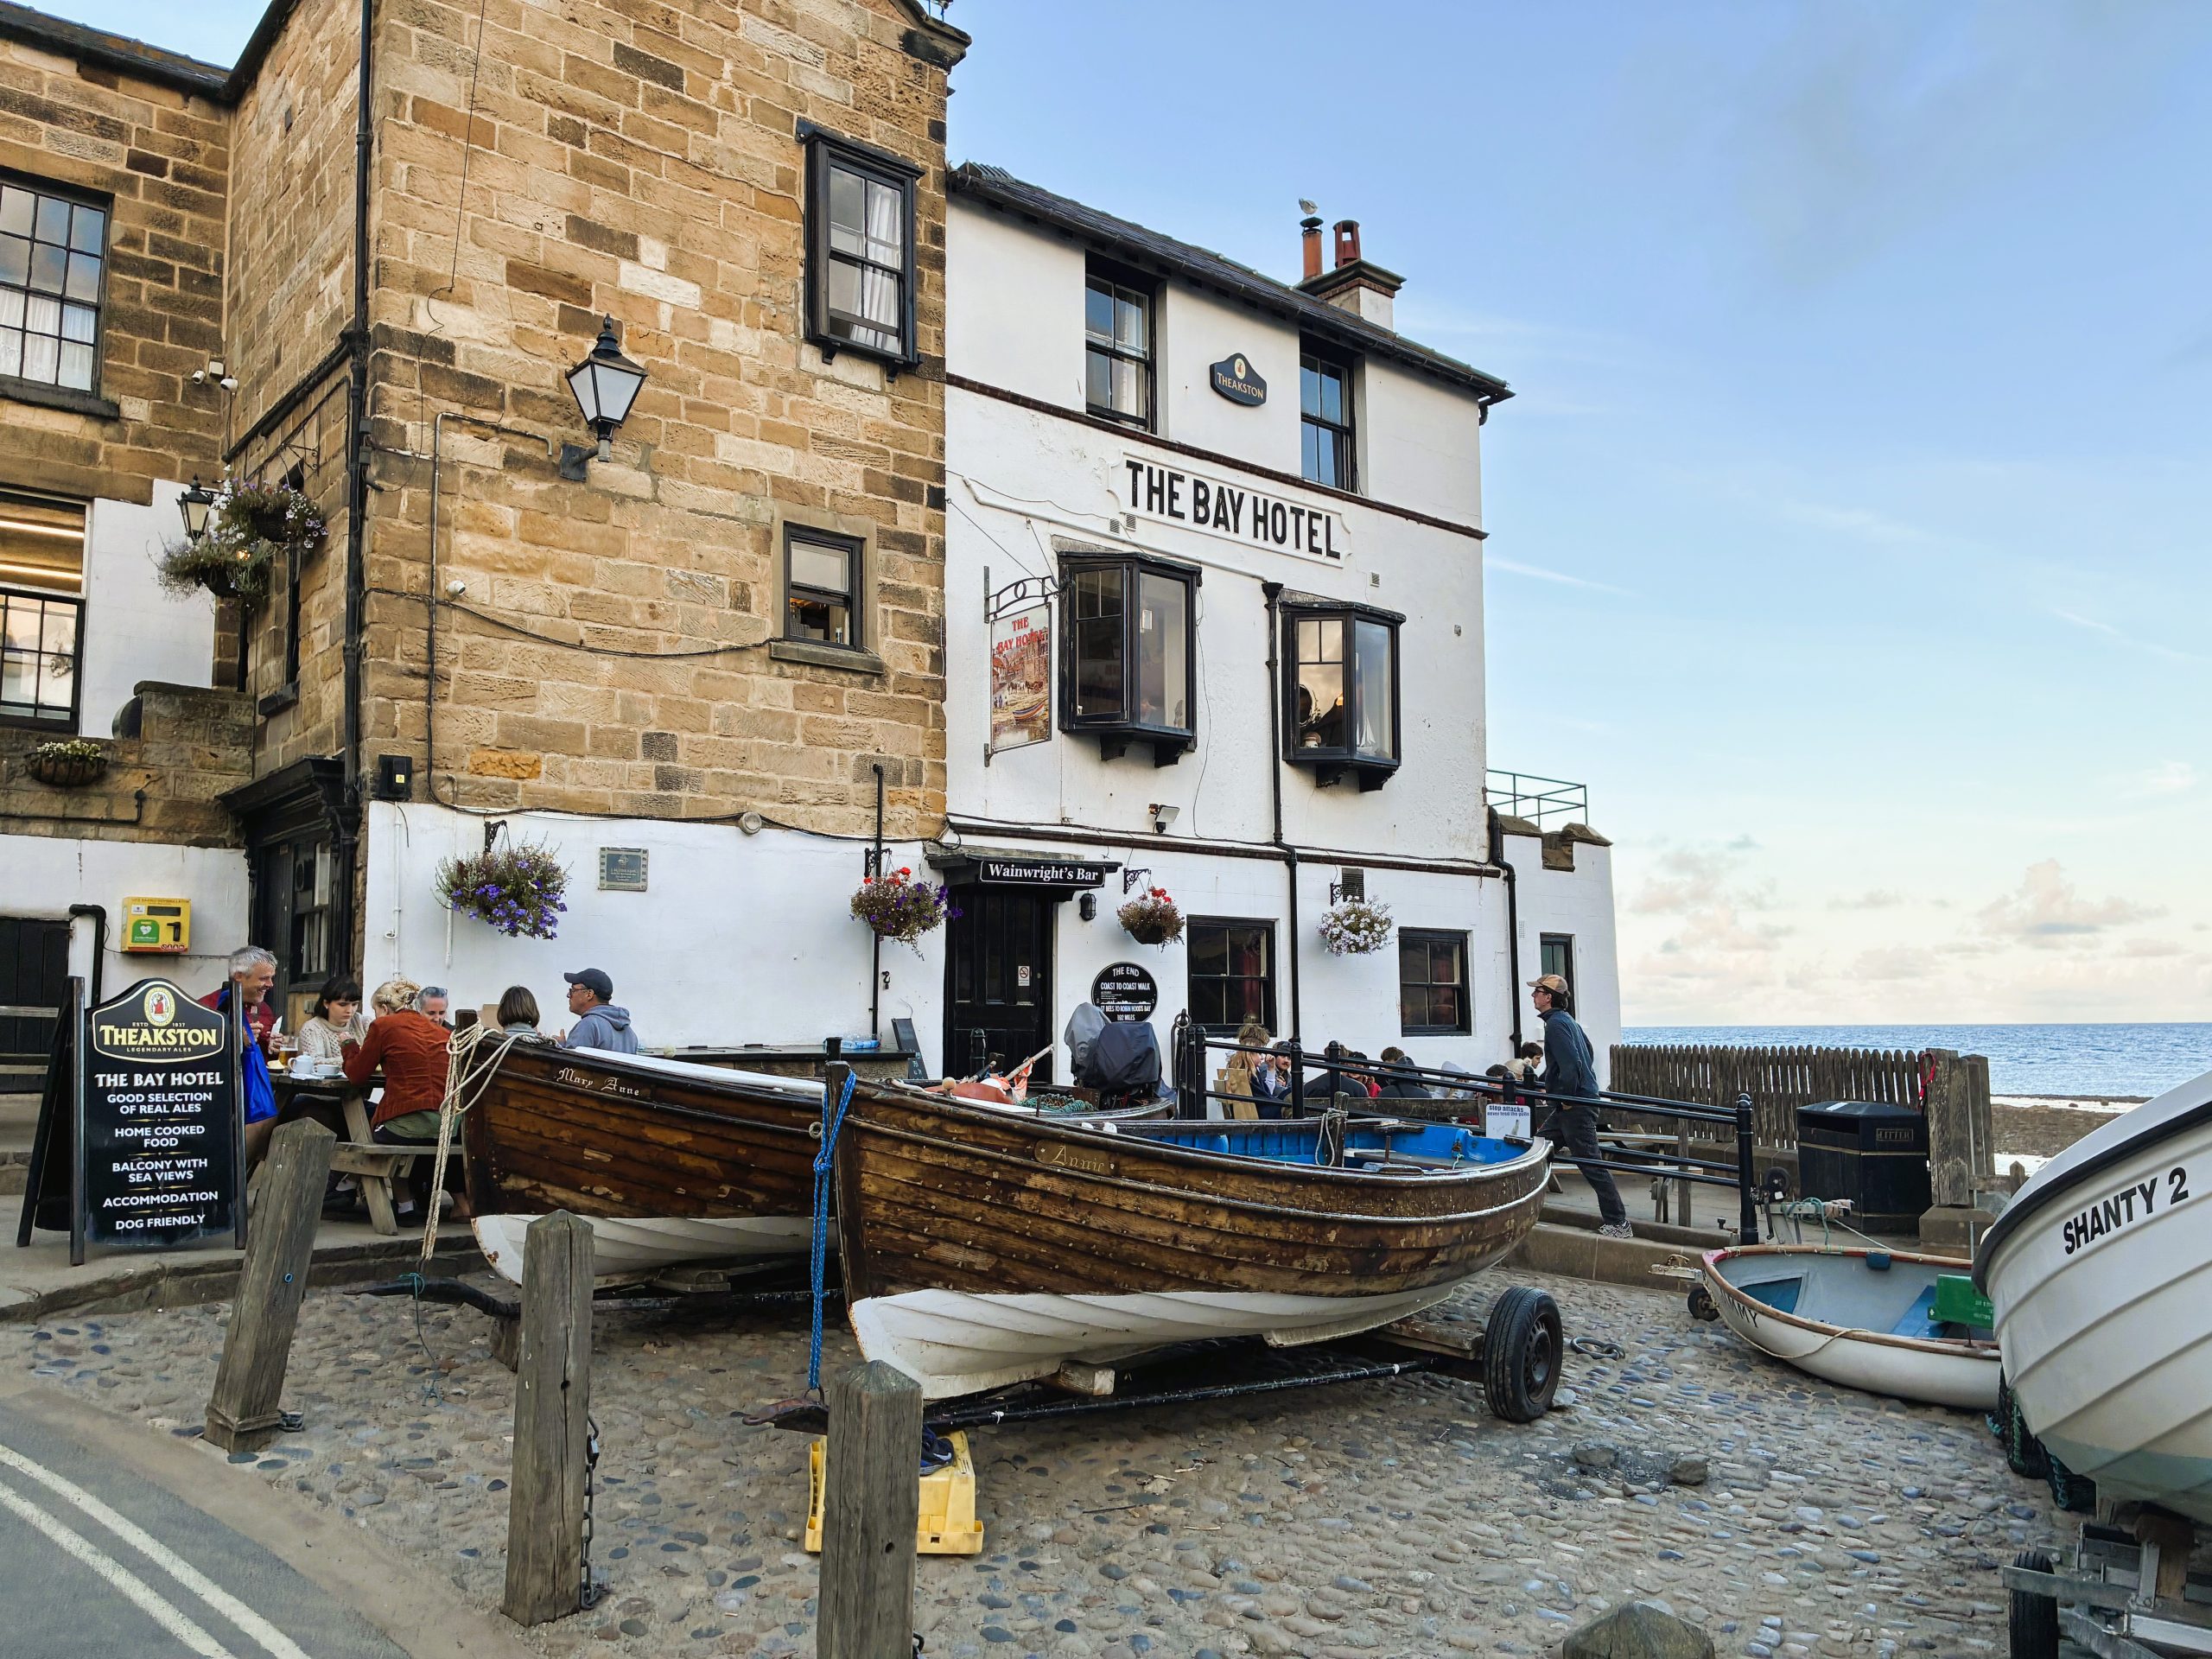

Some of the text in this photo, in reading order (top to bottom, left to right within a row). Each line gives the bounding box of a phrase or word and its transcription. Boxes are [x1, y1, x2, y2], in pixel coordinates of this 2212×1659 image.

[1217, 372, 1263, 399] THEAKSTON
[1126, 460, 1341, 560] THE BAY HOTEL
[1011, 616, 1029, 632] THE
[996, 638, 1014, 654] BAY
[988, 863, 1098, 881] Wainwright's Bar
[1113, 967, 1140, 976] THE END
[99, 1025, 217, 1046] THEAKSTON
[94, 1072, 224, 1087] THE BAY HOTEL
[556, 1067, 639, 1096] Mary Anne
[107, 1092, 213, 1103] GOOD SELECTION
[119, 1103, 201, 1114] OF REAL ALES
[115, 1125, 205, 1137] HOME COOKED
[143, 1138, 179, 1147] FOOD
[112, 1159, 207, 1173] BALCONY WITH
[1050, 1144, 1105, 1173] Annie
[129, 1171, 194, 1182] SEA VIEWS
[102, 1191, 219, 1208] ACCOMMODATION
[2063, 1166, 2189, 1255] SHANTY 2
[116, 1214, 206, 1230] DOG FRIENDLY
